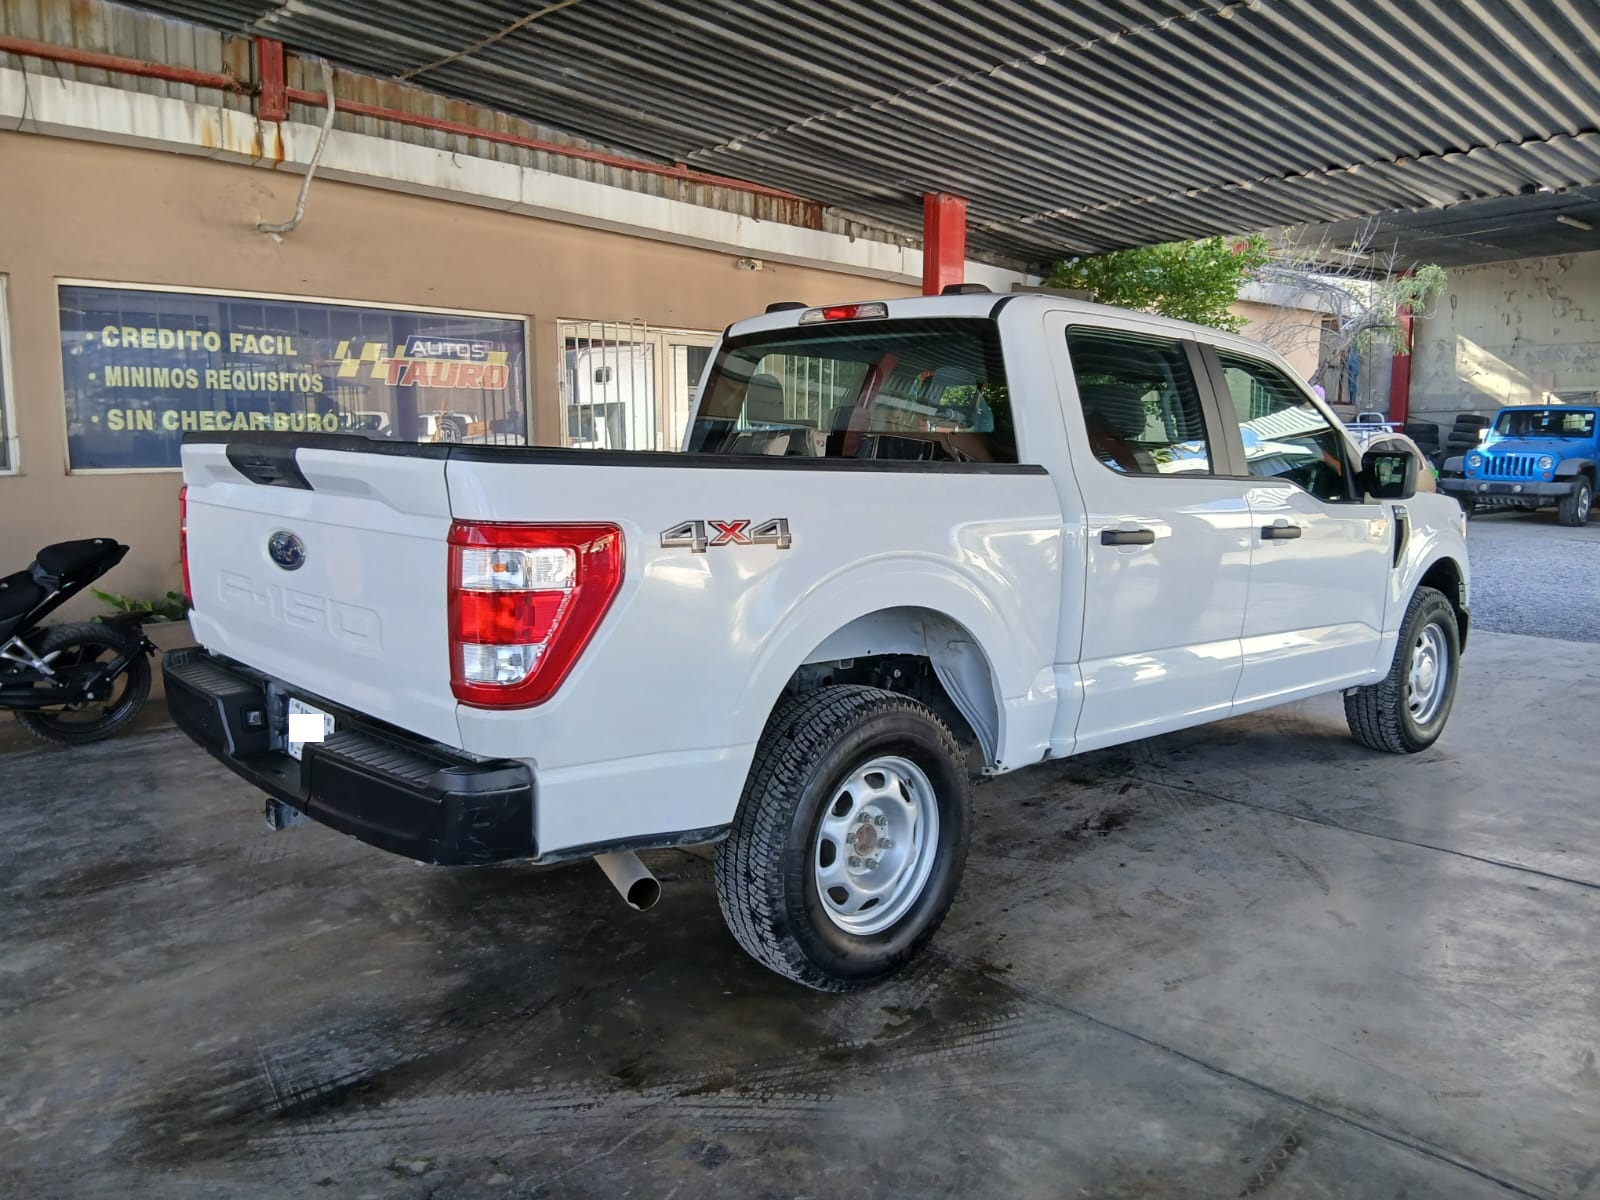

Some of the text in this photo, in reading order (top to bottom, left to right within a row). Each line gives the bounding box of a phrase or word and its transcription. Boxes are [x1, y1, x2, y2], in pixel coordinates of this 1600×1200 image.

[102, 325, 298, 356] CREDITO FACIL
[410, 340, 486, 358] AUTOS
[105, 366, 324, 393] MINIMOS REQUISITOS
[382, 358, 509, 390] TAURO
[107, 409, 153, 431] SIN
[162, 410, 264, 431] CHECAR
[216, 568, 384, 652] F-150
